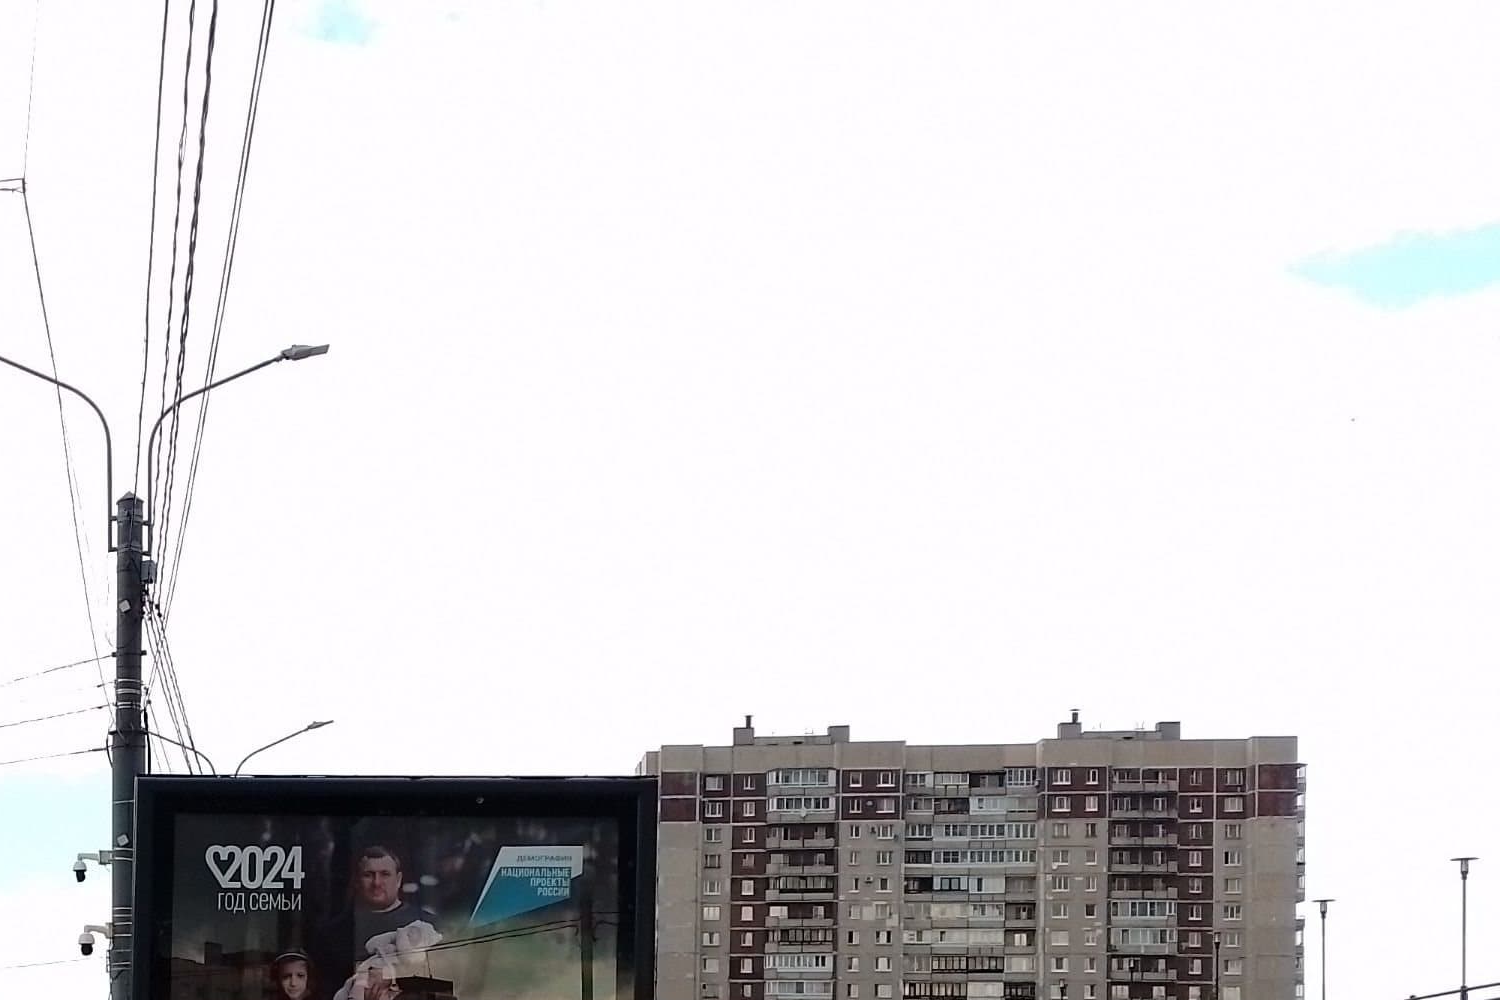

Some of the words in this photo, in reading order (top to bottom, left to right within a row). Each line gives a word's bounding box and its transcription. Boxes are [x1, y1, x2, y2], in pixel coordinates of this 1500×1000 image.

[205, 845, 305, 889] 2024
[501, 867, 571, 878] НАЦИОНАЛЬНЫЕ
[530, 878, 571, 887] ПРОЕКТЫ
[537, 887, 570, 896] РОССИИ
